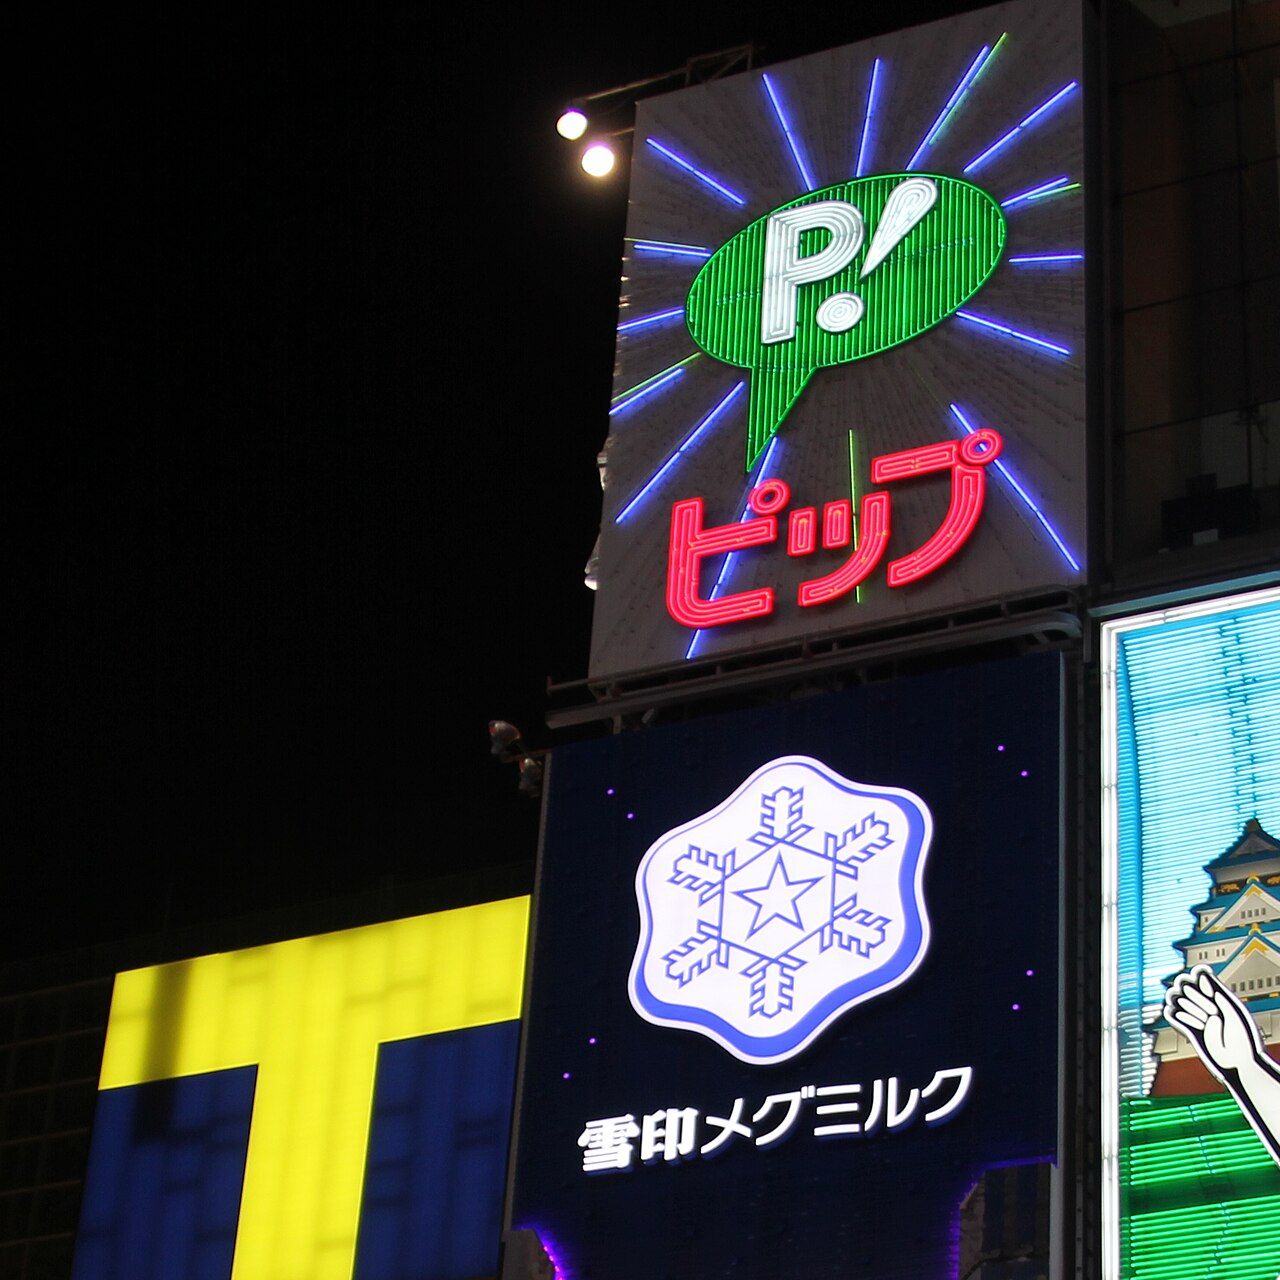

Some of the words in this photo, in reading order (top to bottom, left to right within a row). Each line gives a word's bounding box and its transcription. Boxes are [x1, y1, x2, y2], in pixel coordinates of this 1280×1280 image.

[666, 428, 1003, 629] ピップ
[577, 1066, 972, 1174] 雪印メグミルク
